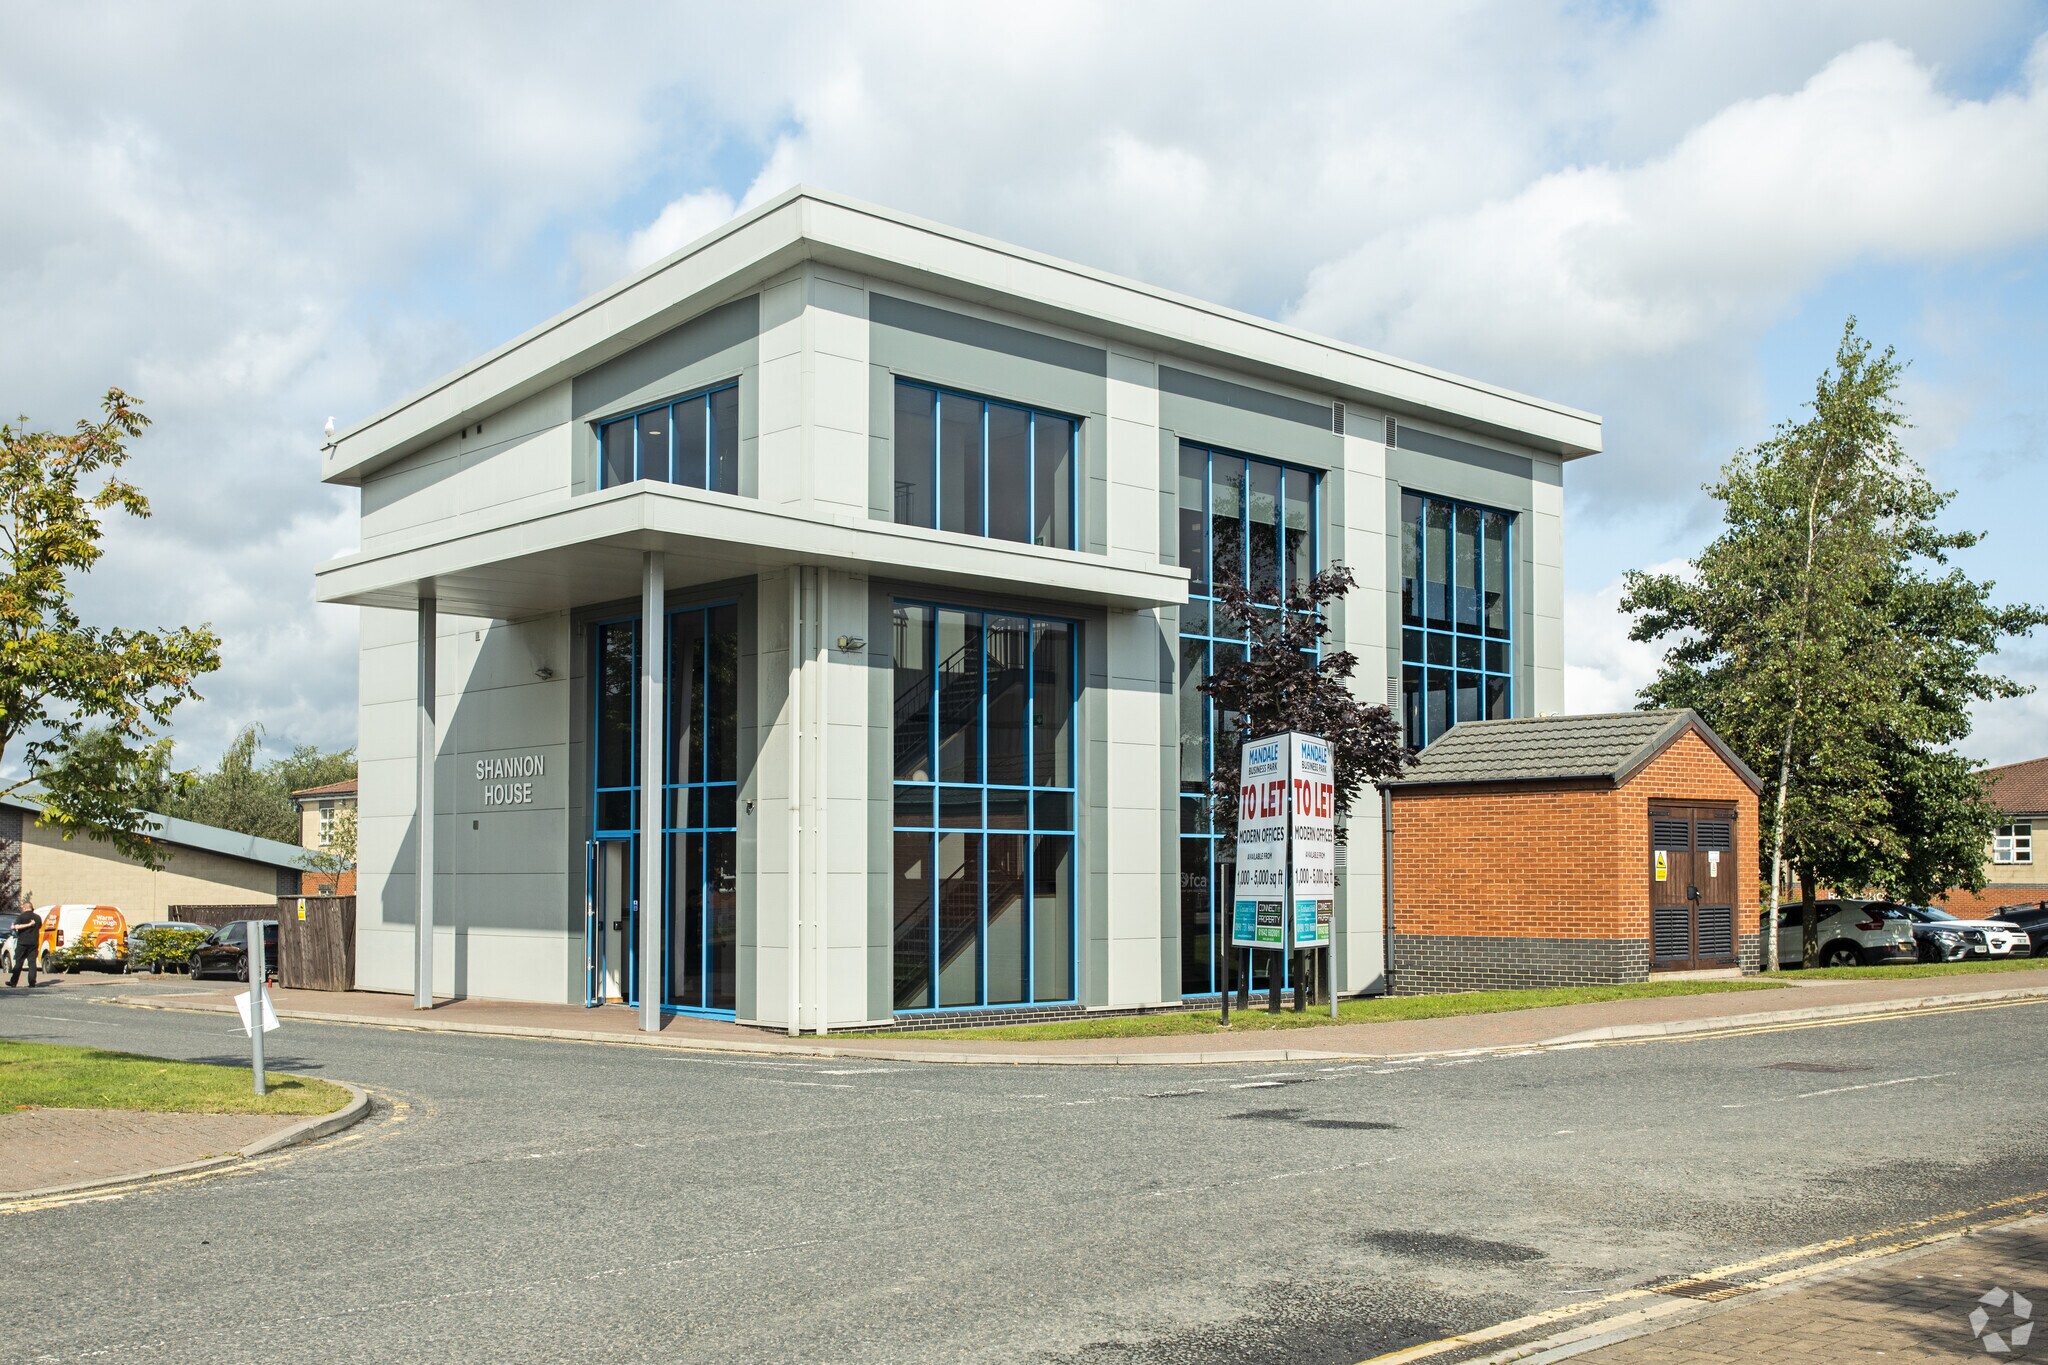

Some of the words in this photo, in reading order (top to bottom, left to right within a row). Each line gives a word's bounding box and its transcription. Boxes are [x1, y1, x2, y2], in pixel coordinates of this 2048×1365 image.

[1249, 744, 1278, 765] MANDALE
[1301, 743, 1327, 763] MANDALE
[476, 755, 544, 780] SHANNON
[1248, 764, 1267, 775] BUSINESS
[1267, 762, 1278, 772] PARK
[1301, 761, 1319, 772] BUSINESS
[1319, 763, 1327, 773] PARK
[485, 782, 532, 805] HOUSE
[1242, 784, 1257, 820] TO
[1260, 780, 1286, 818] LET
[1294, 779, 1311, 816] TO
[1315, 782, 1333, 818] LET
[1239, 828, 1261, 843] MODERN
[1261, 826, 1285, 842] OFFICES
[1294, 826, 1316, 840] MODERN
[1316, 828, 1333, 842] OFFICES
[1263, 852, 1273, 860] FROM
[1190, 873, 1207, 887] fca
[1237, 870, 1250, 888] 1,000
[1254, 869, 1269, 888] 5,000
[1269, 872, 1276, 888] sq
[1277, 869, 1283, 885] ft
[1295, 868, 1309, 886] 1,000
[1258, 915, 1280, 924] PROPERTY
